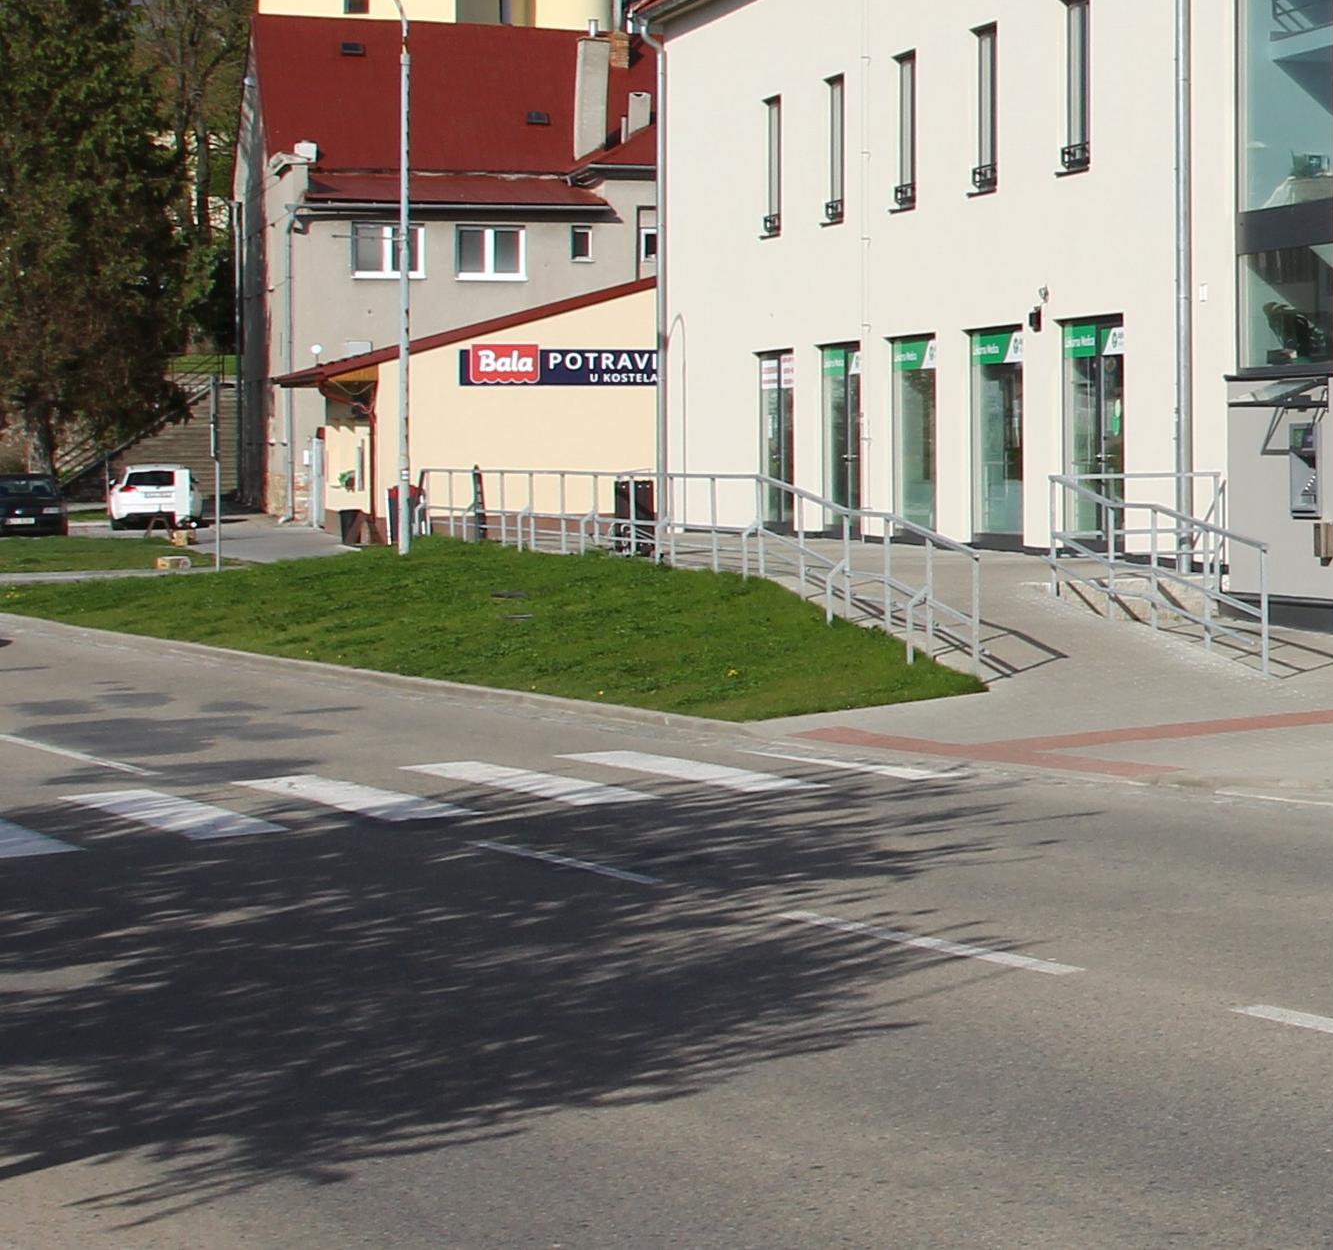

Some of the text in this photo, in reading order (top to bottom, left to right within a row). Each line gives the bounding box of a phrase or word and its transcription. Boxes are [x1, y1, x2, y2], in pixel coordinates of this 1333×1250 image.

[477, 349, 657, 373] Bala POTRAVI
[590, 373, 658, 383] U KOSTELA
